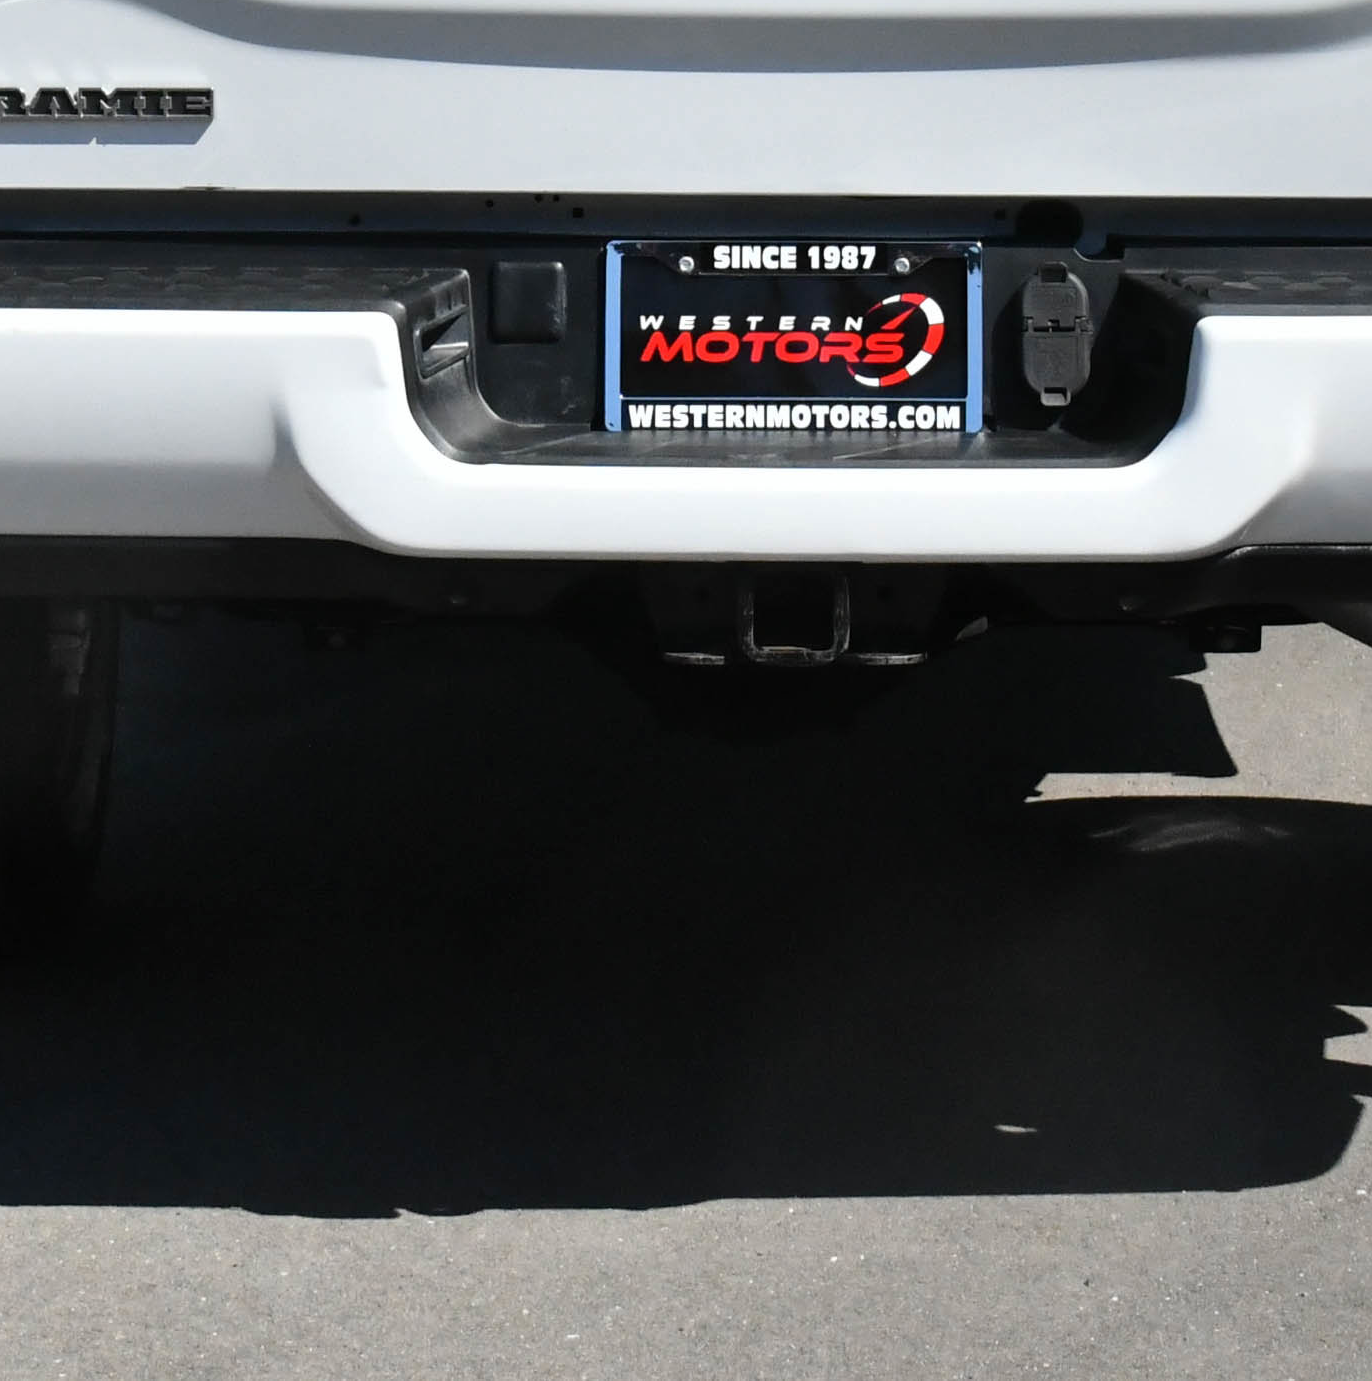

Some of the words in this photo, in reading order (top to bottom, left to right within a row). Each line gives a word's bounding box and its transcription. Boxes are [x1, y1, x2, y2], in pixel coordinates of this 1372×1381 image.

[713, 245, 797, 270] SINCE
[808, 245, 877, 270] 1987
[640, 315, 864, 332] WESTERN
[640, 331, 906, 364] MOTORS
[628, 404, 961, 430] WESTERNMOTORS.COM
